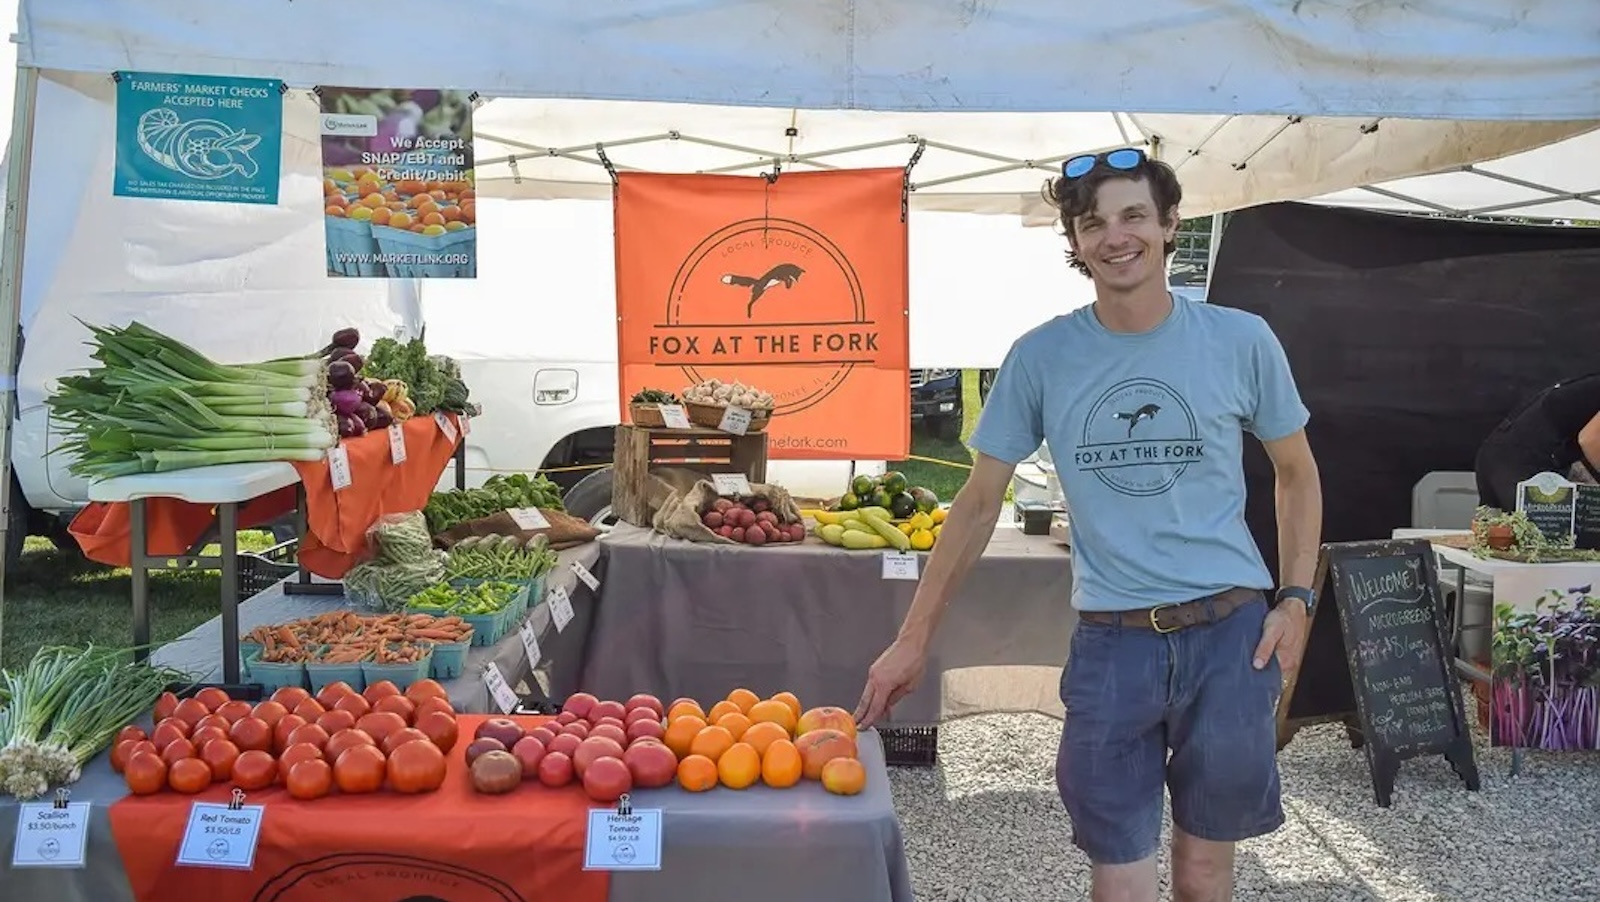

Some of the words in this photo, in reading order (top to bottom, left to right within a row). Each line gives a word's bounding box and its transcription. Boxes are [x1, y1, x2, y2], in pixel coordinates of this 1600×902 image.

[185, 85, 226, 96] MARKET
[229, 88, 268, 98] CHECKS
[163, 96, 215, 107] ACCEPTED
[218, 99, 243, 109] HERE
[390, 137, 412, 149] We
[415, 137, 464, 151] Accept
[362, 152, 437, 165] SNAP/EBT
[438, 154, 465, 166] and
[377, 169, 466, 182] Credit/Debit
[721, 240, 755, 258] LOCAL
[761, 237, 814, 258] PRODUCE
[650, 336, 700, 355] FOX
[712, 336, 742, 354] AT
[755, 335, 800, 353] THE
[813, 333, 879, 351] FORK
[1075, 451, 1103, 465] FOX
[1110, 449, 1127, 461] AT
[1134, 446, 1158, 458] THE
[1165, 445, 1205, 457] FORK
[1349, 570, 1414, 604] WELCOME
[1369, 606, 1432, 633] MICROGREENS
[37, 811, 70, 820] Scallion
[201, 813, 218, 822] Red
[220, 815, 251, 824] Tomato
[607, 814, 642, 823] Heritage
[609, 825, 640, 833] Tomato
